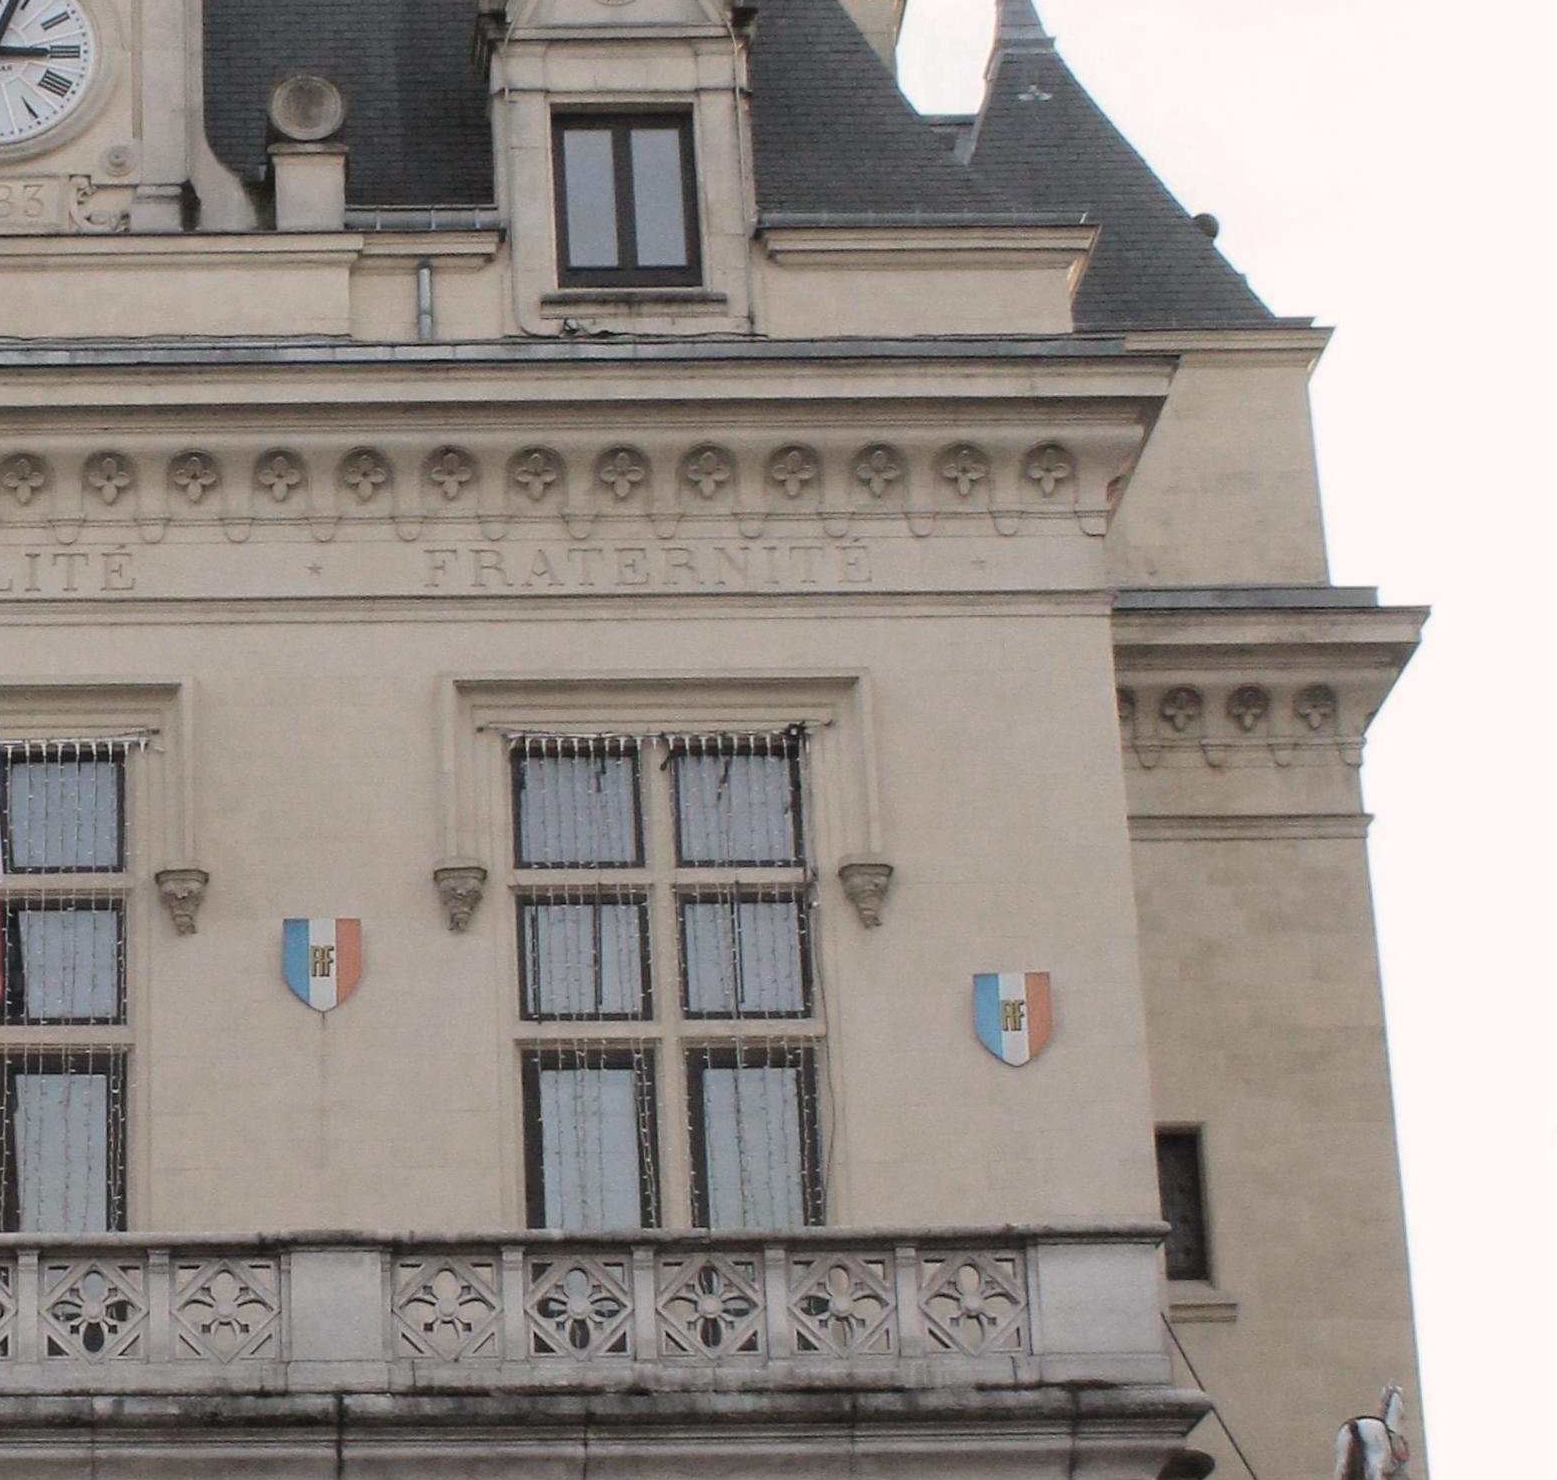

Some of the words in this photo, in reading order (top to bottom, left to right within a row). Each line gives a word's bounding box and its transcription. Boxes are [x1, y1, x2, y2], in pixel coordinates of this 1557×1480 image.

[422, 539, 873, 591] FRATERNITÉ
[310, 945, 334, 977] RF
[1000, 1000, 1025, 1032] RF
